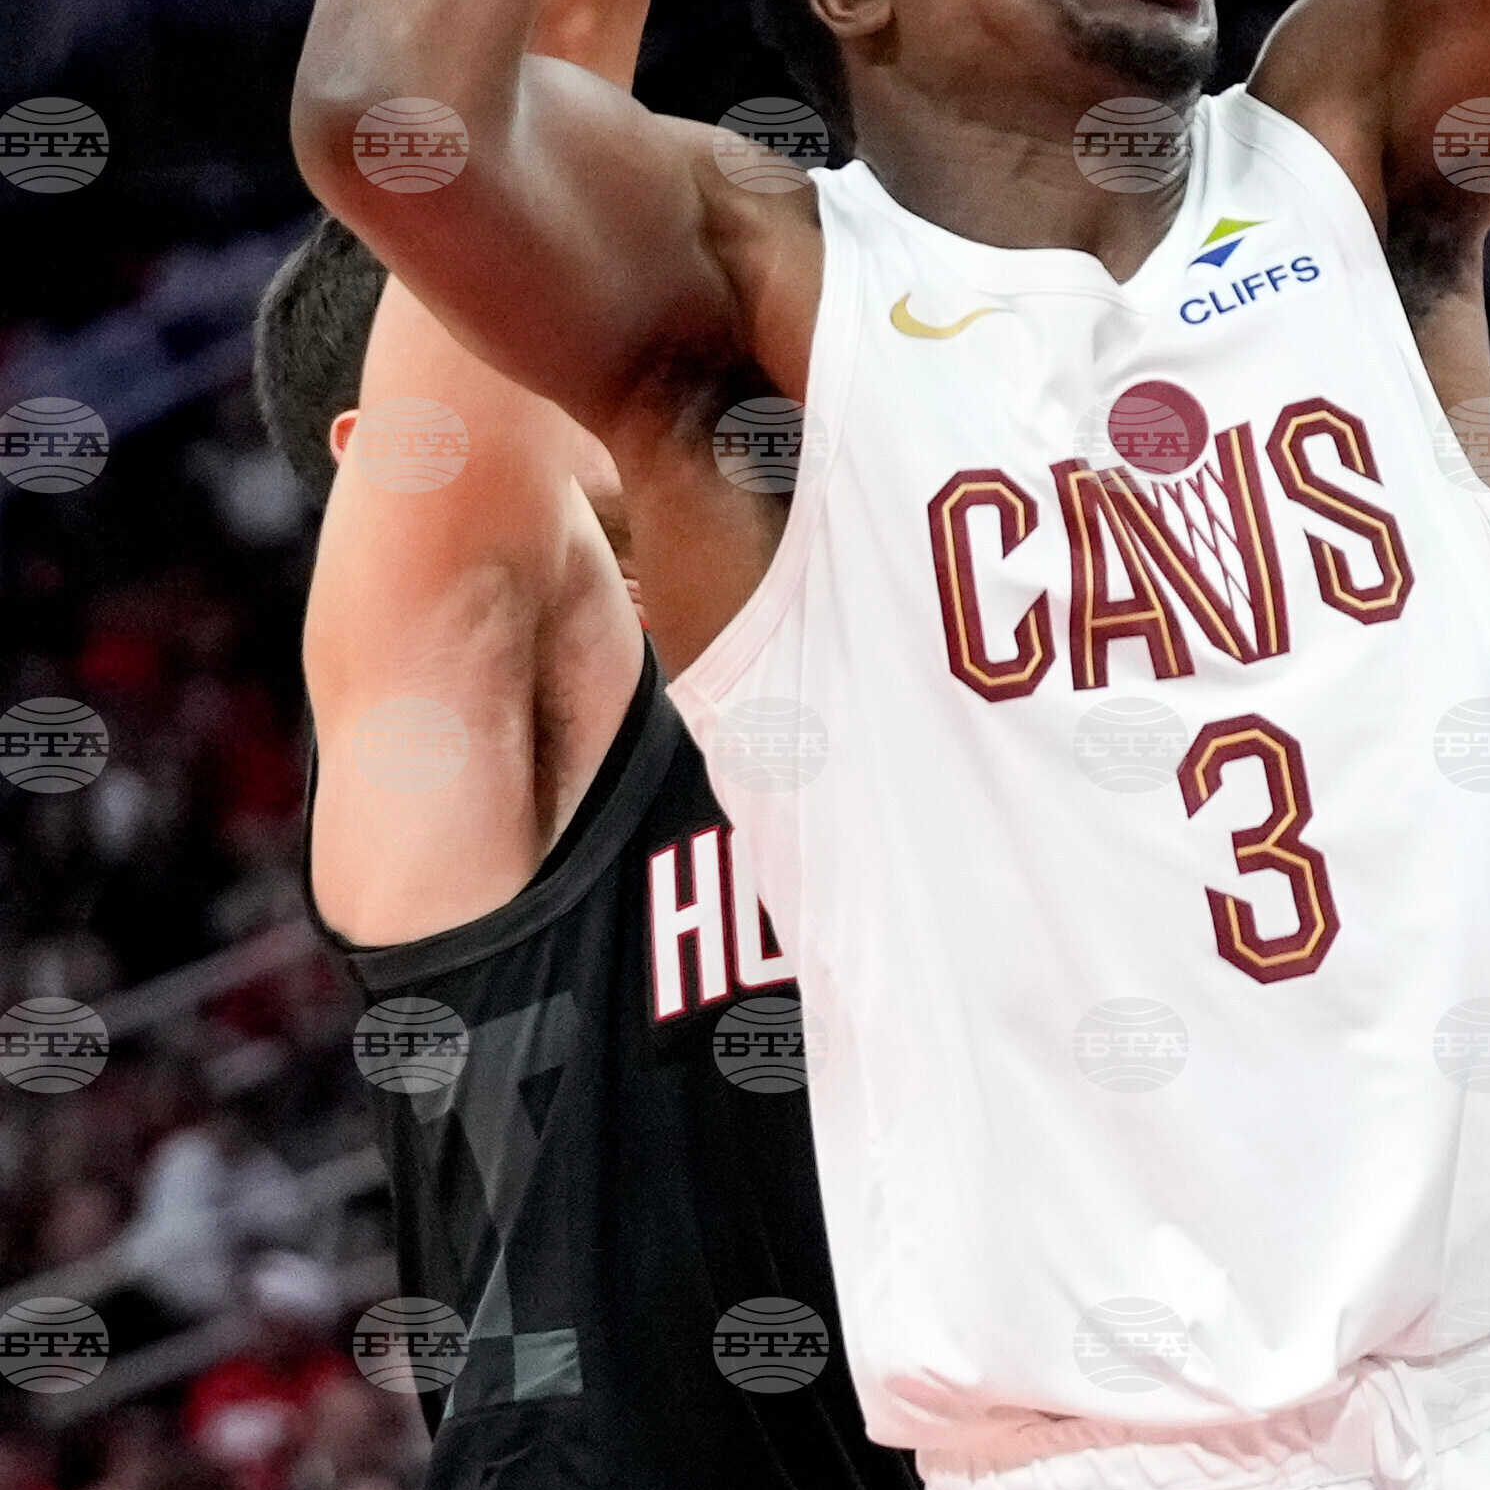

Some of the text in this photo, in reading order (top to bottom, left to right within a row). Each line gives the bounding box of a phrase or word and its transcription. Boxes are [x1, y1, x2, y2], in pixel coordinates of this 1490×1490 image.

[1179, 256, 1320, 324] CLIFFS
[926, 396, 1416, 703] CAVS
[1176, 712, 1342, 985] 3
